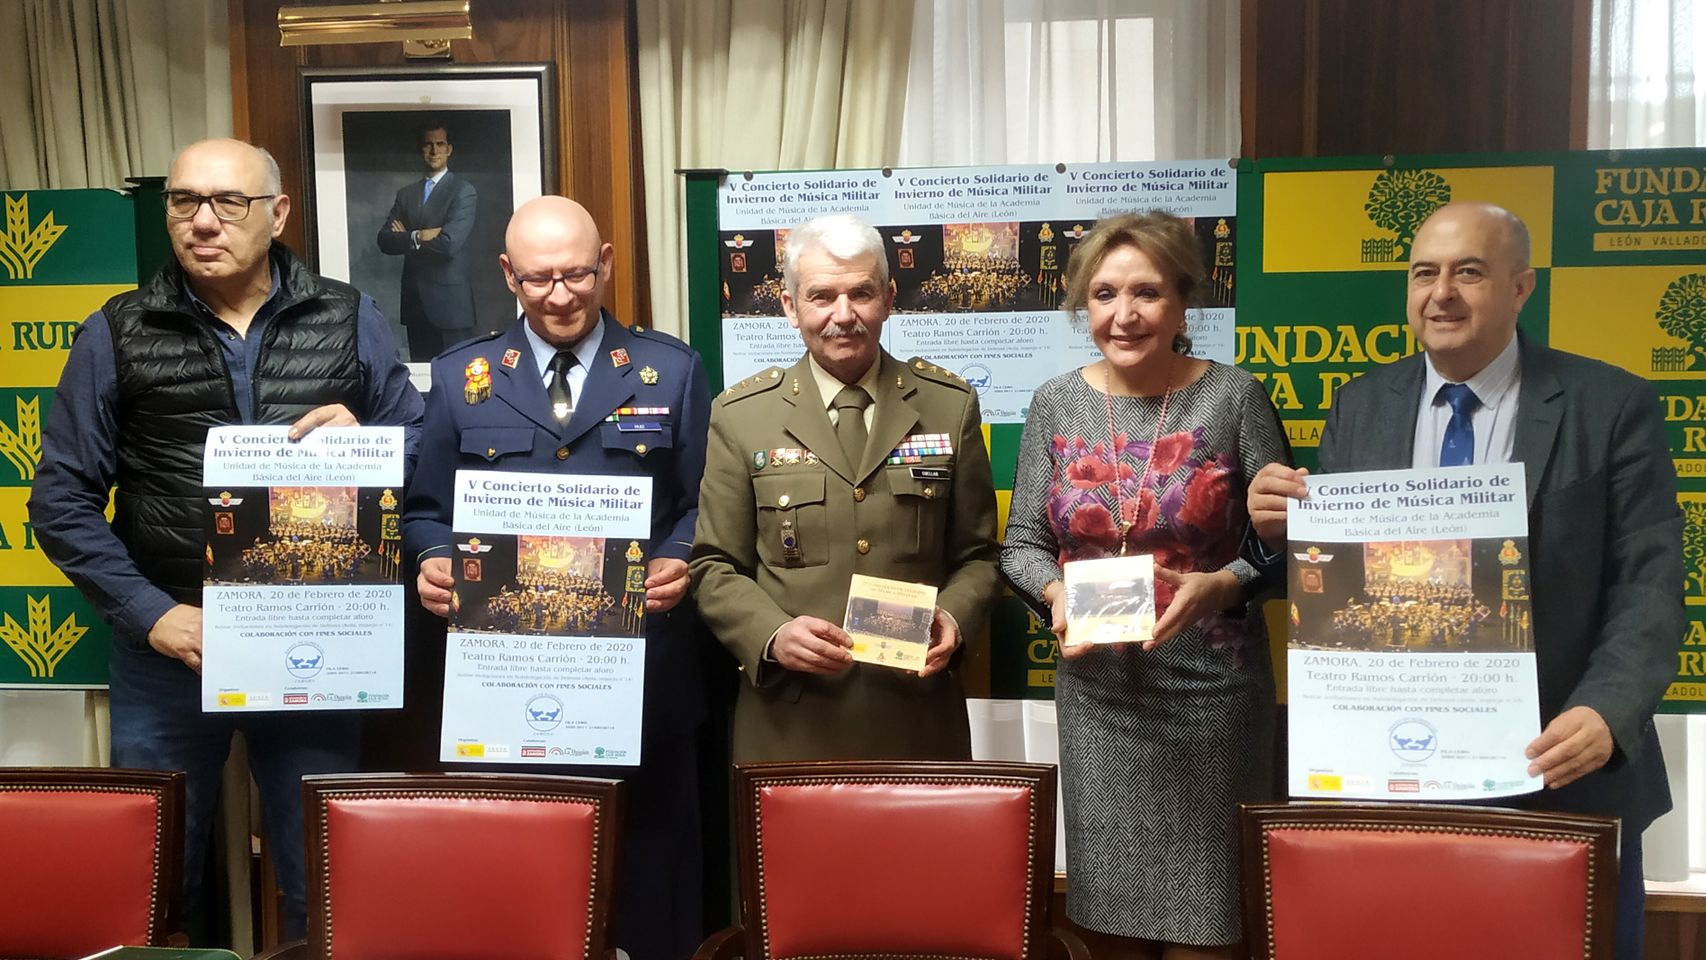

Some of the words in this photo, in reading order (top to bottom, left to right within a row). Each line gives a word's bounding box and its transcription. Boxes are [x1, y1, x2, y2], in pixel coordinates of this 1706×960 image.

[898, 178, 906, 187] V
[910, 176, 969, 187] Concierto
[974, 174, 1030, 184] Solidario
[1034, 172, 1048, 182] de
[1070, 172, 1078, 181] V
[1083, 170, 1144, 181] Concierto
[1149, 169, 1206, 179] Solidario
[1211, 168, 1226, 177] de
[729, 183, 738, 191] V
[742, 181, 800, 191] Concierto
[804, 180, 858, 190] Solidario
[863, 179, 877, 188] de
[895, 189, 945, 199] Invierno
[948, 188, 963, 198] de
[967, 186, 1008, 197] Música
[1013, 184, 1052, 195] Militar
[1067, 183, 1117, 193] Invierno
[1122, 183, 1137, 193] de
[1141, 181, 1184, 192] Música
[1188, 180, 1229, 190] Militar
[727, 193, 775, 204] Invierno
[780, 193, 794, 203] de
[798, 191, 837, 202] Música
[842, 190, 880, 201] Militar
[1076, 197, 1104, 205] Unidad
[1107, 196, 1117, 204] de
[1121, 195, 1149, 204] Música
[1165, 194, 1172, 202] la
[1175, 193, 1216, 202] Academia
[904, 202, 931, 211] Unidad
[934, 202, 944, 210] de
[947, 201, 974, 209] Música
[977, 200, 988, 208] de
[990, 199, 997, 208] la
[1000, 198, 1040, 207] Academia
[929, 211, 955, 220] Básica
[957, 211, 970, 219] del
[973, 209, 988, 218] Aire
[992, 209, 1017, 218] (León)
[1594, 199, 1680, 227] CAJA
[1610, 234, 1640, 246] LEÓN
[733, 322, 773, 330] ZAMORA,
[900, 319, 941, 327] ZAMORA,
[1012, 316, 1022, 324] de
[1026, 316, 1049, 324] 2020
[736, 333, 763, 341] Teatro
[219, 435, 227, 444] V
[375, 436, 391, 445] de
[214, 448, 270, 457] Invierno
[277, 448, 293, 458] de
[351, 448, 395, 458] Militar
[469, 480, 477, 489] V
[483, 480, 552, 493] Concierto
[557, 484, 619, 495] Solidario
[624, 486, 640, 495] de
[1318, 482, 1399, 496] Concierto
[1406, 477, 1483, 492] Solidario
[1490, 475, 1510, 487] de
[464, 493, 521, 505] Invierno
[527, 496, 543, 506] de
[549, 497, 595, 508] Música
[600, 499, 643, 509] Militar
[1298, 499, 1365, 511] Invierno
[1371, 497, 1391, 509] de
[1397, 494, 1454, 507] Música
[1460, 492, 1515, 504] Militar
[474, 509, 506, 518] Unidad
[510, 510, 521, 518] de
[524, 511, 556, 520] Música
[559, 512, 570, 520] de
[574, 513, 582, 521] la
[1310, 516, 1348, 524] Unidad
[1352, 516, 1365, 524] de
[1370, 514, 1407, 523] Música
[1412, 513, 1425, 522] de
[1443, 510, 1500, 520] Academia
[503, 521, 532, 530] Básica
[536, 522, 549, 530] del
[553, 523, 571, 531] Aire
[575, 524, 603, 532] (León)
[1345, 527, 1380, 537] Básica
[1384, 527, 1401, 536] del
[1405, 525, 1427, 535] Aire
[1432, 524, 1467, 534] (León)
[216, 591, 266, 600] ZAMORA,
[271, 591, 284, 599] 20
[288, 590, 300, 599] de
[304, 590, 344, 599] Febrero
[348, 590, 361, 599] de
[365, 590, 391, 599] 2020
[219, 604, 252, 612] Teatro
[257, 604, 292, 612] Ramos
[296, 603, 335, 611] Carrión
[346, 603, 376, 611] 20:00
[380, 603, 389, 611] h.
[459, 639, 509, 649] ZAMORA,
[513, 640, 527, 649] 20
[530, 640, 543, 650] de
[547, 641, 586, 651] Febrero
[590, 642, 602, 651] de
[606, 643, 633, 652] 2020
[462, 652, 495, 661] Teatro
[499, 653, 534, 662] Ramos
[538, 653, 576, 663] Carrión
[587, 655, 617, 664] 20:00
[620, 656, 629, 665] h.
[1304, 656, 1361, 667] ZAMORA,
[1368, 658, 1384, 667] 20
[1389, 658, 1404, 668] de
[1410, 658, 1459, 668] Febrero
[1464, 659, 1479, 668] de
[1485, 659, 1520, 668] 2020
[1307, 670, 1347, 681] Teatro
[1351, 672, 1395, 682] Ramos
[1400, 672, 1447, 683] Carrión
[1462, 673, 1500, 683] 20:00
[1506, 674, 1518, 683] h.
[482, 681, 537, 689] COLABORACIÓN
